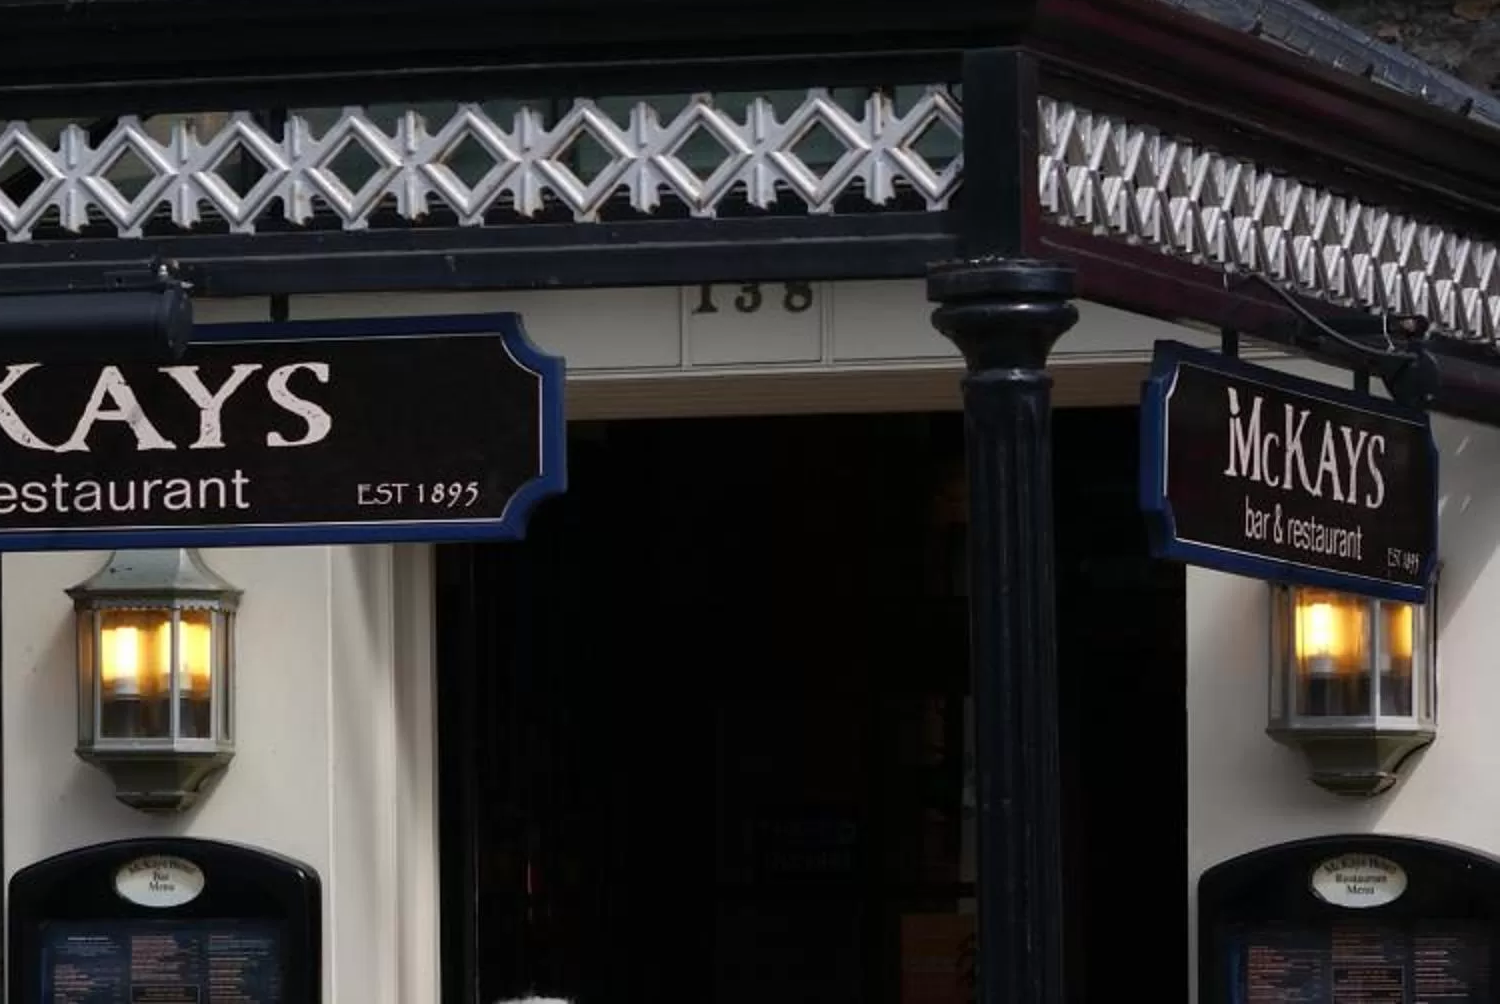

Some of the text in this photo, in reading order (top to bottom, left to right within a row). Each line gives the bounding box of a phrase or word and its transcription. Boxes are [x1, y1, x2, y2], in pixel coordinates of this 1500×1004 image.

[357, 481, 479, 508] EST 1895
[1245, 495, 1364, 561] bar & restaurant
